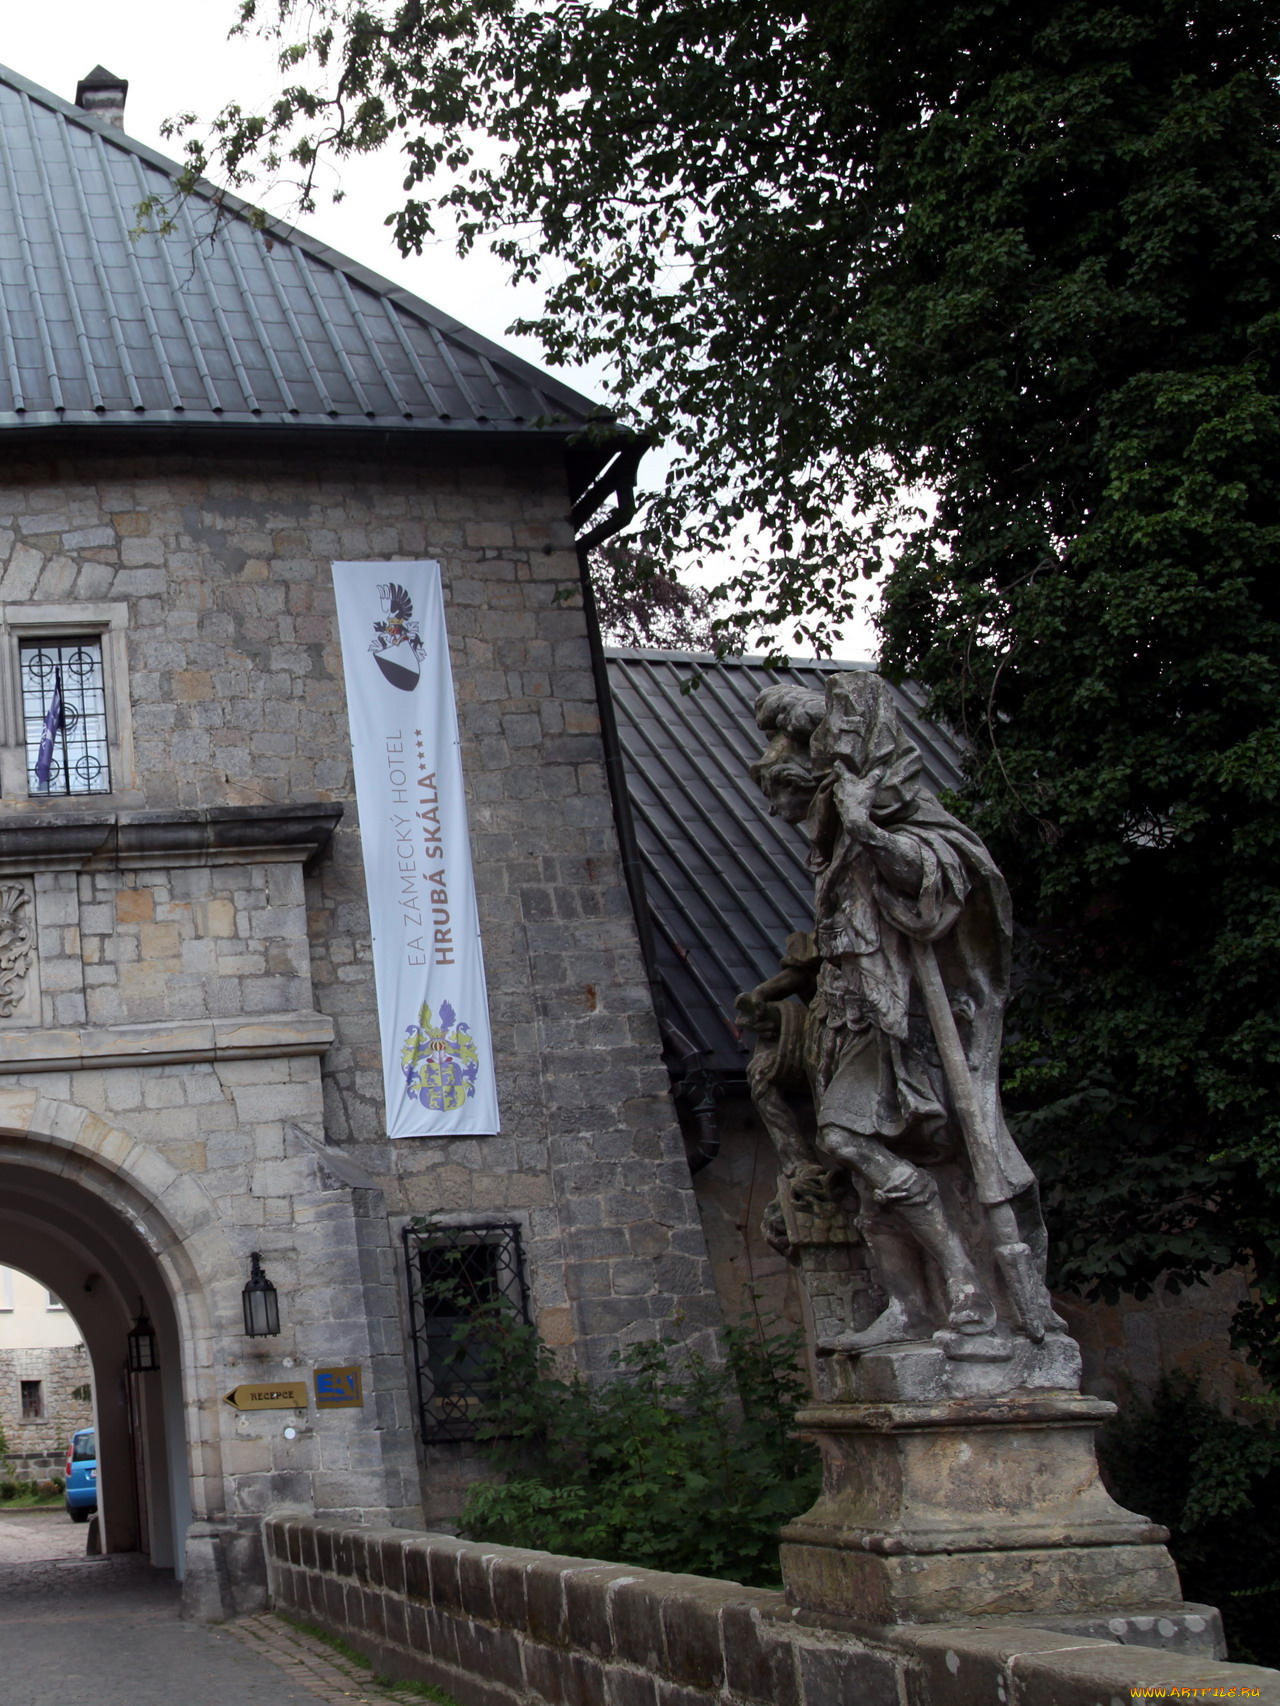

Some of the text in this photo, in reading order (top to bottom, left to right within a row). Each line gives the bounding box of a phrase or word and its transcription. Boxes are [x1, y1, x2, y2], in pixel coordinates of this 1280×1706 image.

[385, 729, 426, 965] EA ZÁMECKÝ HOTEL
[416, 771, 455, 965] HRUBÁ SKÁLA
[250, 1390, 295, 1401] RECEPCE
